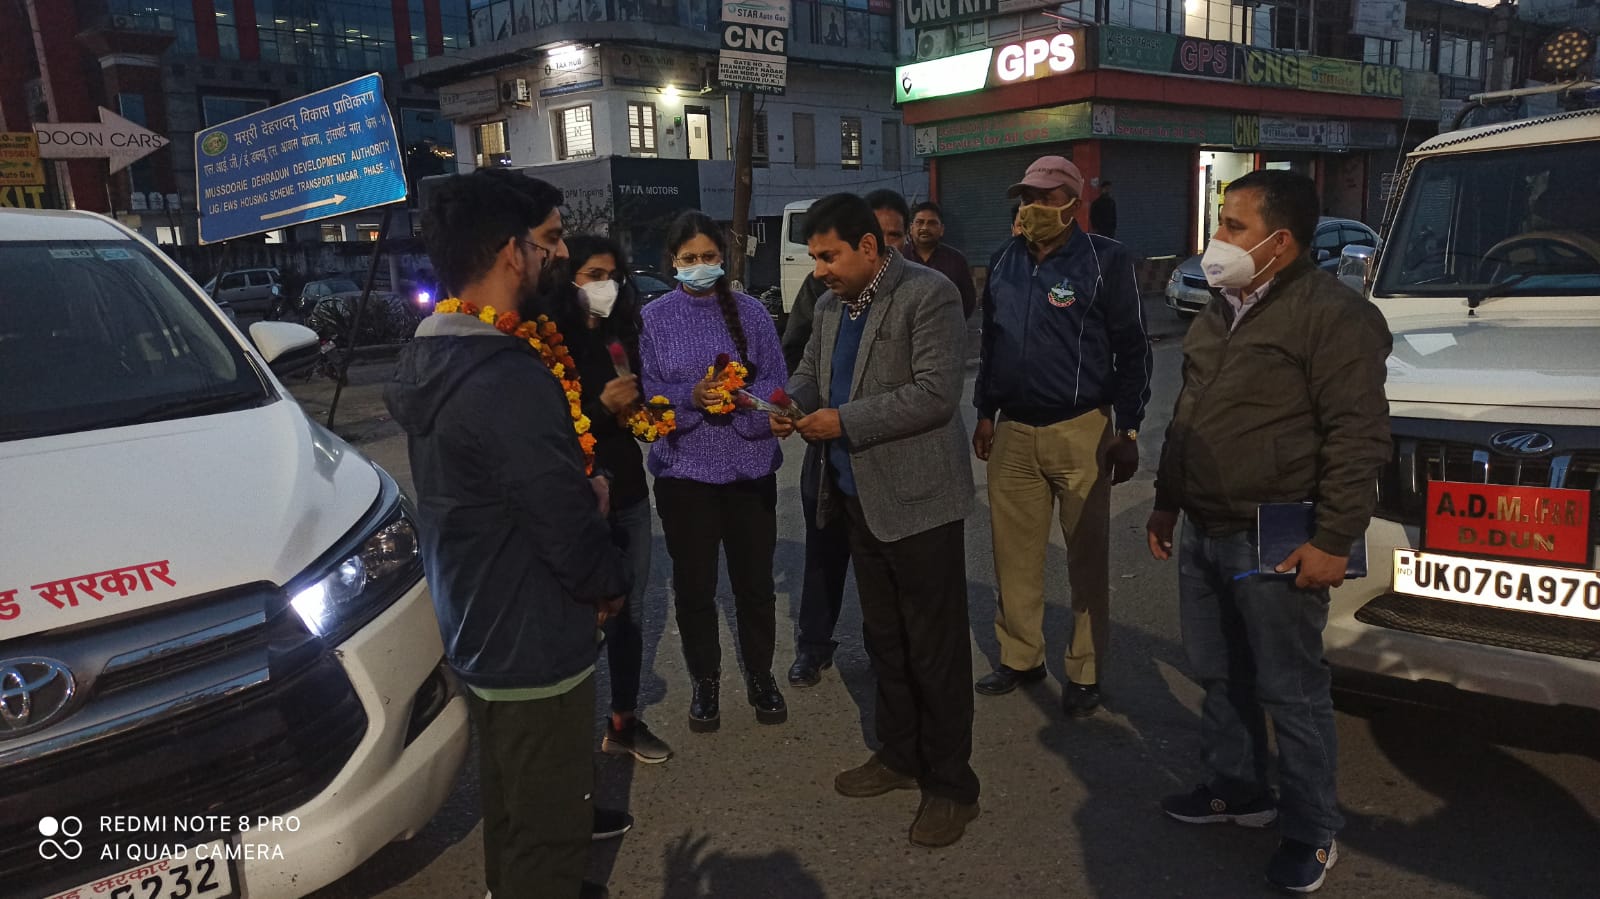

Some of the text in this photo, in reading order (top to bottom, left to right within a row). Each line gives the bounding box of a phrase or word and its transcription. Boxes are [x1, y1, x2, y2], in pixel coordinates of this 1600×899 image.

[737, 8, 758, 18] STAR
[724, 25, 784, 53] CNG
[720, 63, 759, 72] TRANSPORT
[997, 33, 1076, 81] GPS
[1180, 40, 1227, 74] GPS
[1247, 49, 1299, 85] CNG
[724, 73, 761, 82] DEHRADUN
[760, 72, 784, 80] OFFICE
[1362, 64, 1402, 96] CNG
[300, 105, 330, 128] विकास
[1234, 114, 1259, 146] CNG
[37, 130, 103, 147] DOON
[111, 132, 162, 148] CARS
[205, 139, 391, 198] MUSSOORIE DEHRADUN DEVELOPMENT AUTHORITY
[240, 191, 268, 208] HOUSING
[297, 176, 335, 196] TRANSPORT
[618, 184, 680, 196] TATA MOTORS
[1458, 527, 1555, 552] D.DUN
[30, 559, 177, 610] सरकार
